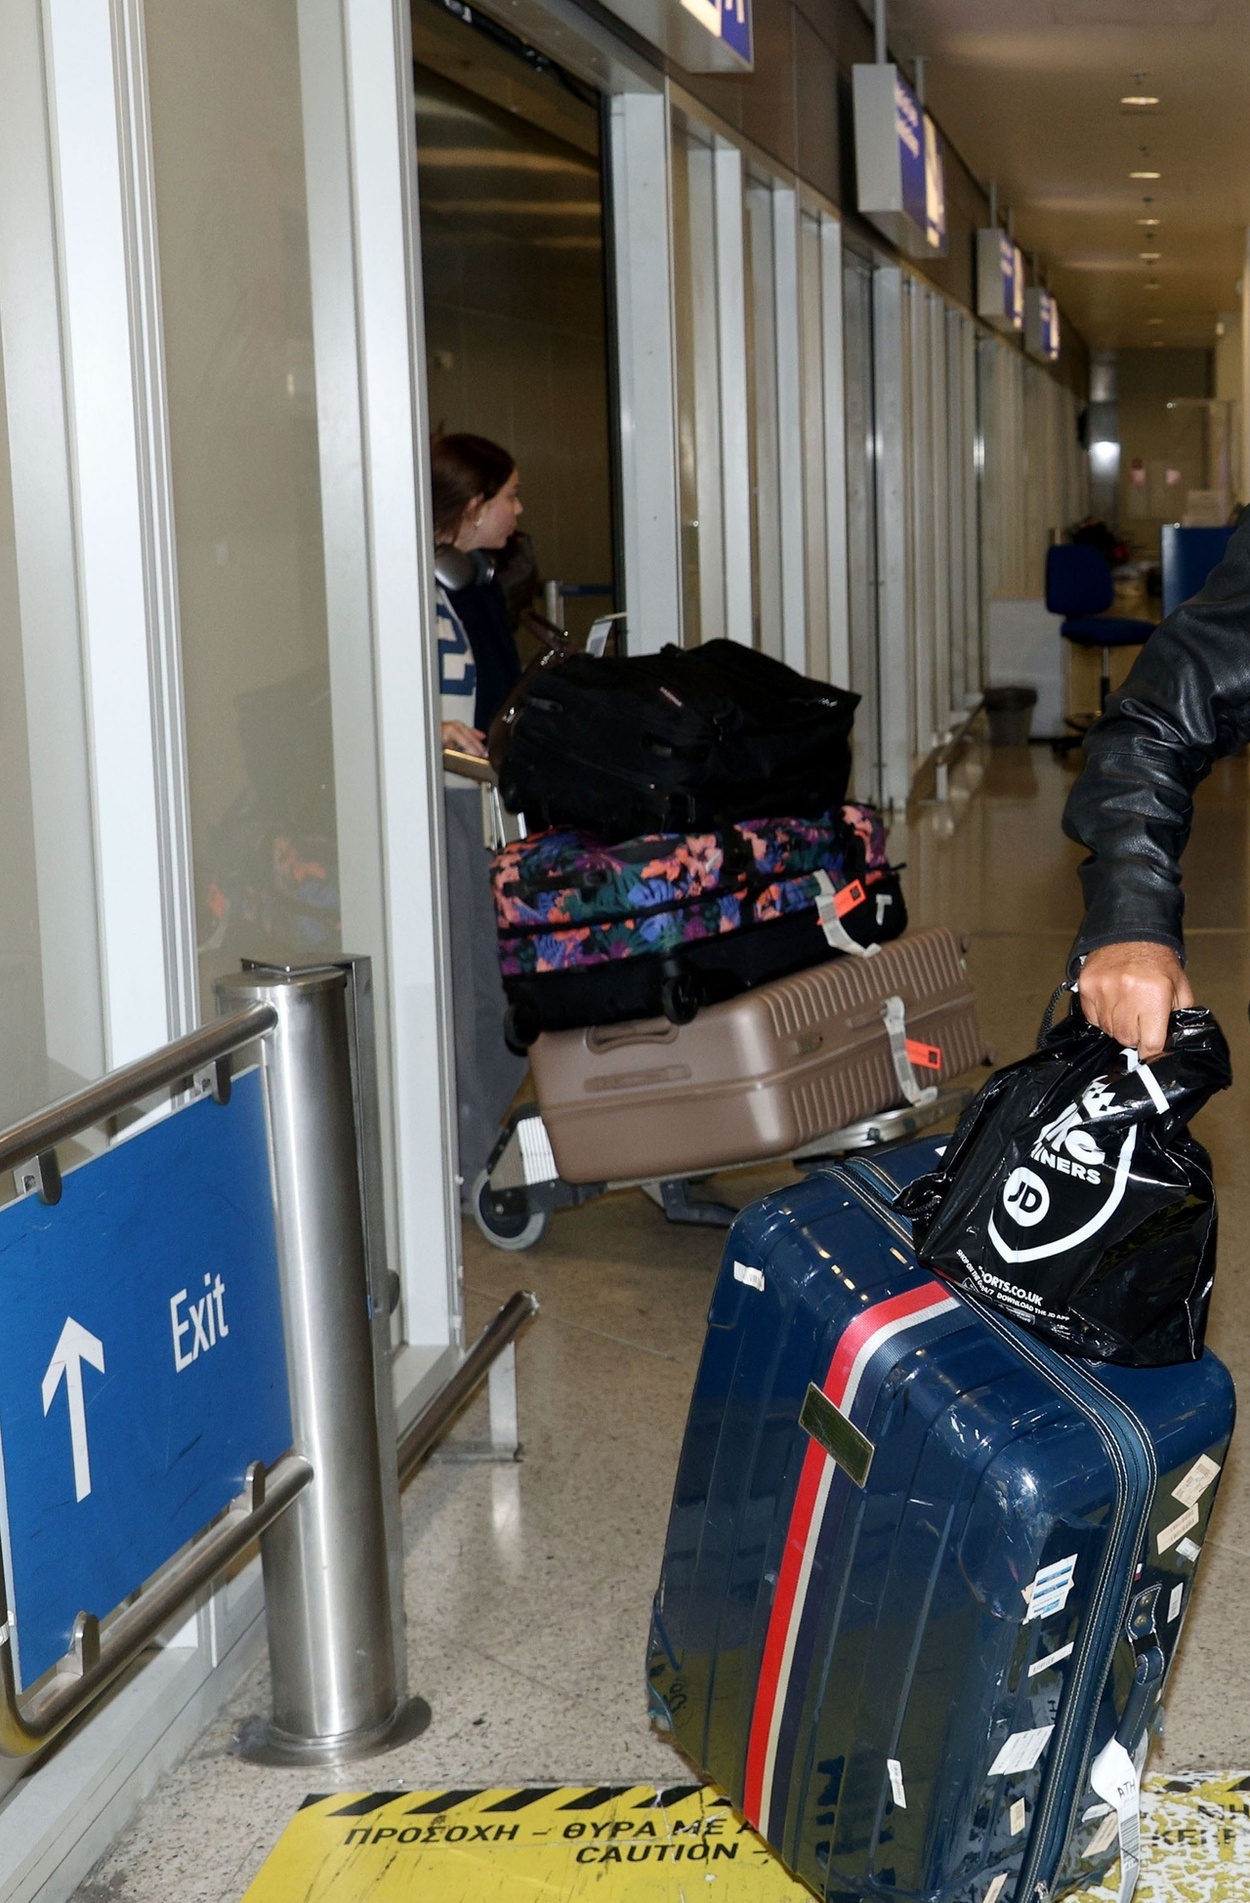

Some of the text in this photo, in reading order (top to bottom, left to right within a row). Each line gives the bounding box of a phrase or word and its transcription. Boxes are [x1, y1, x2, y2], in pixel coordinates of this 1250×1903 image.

[1007, 1180, 1043, 1214] JD
[996, 1292, 1034, 1312] DOWNLOAD
[170, 1272, 229, 1373] Exit
[344, 1824, 520, 1845] ΠΡΟΣΟΧΗ
[563, 1820, 657, 1839] ΘΥΡΑ
[576, 1842, 739, 1864] CAUTION
